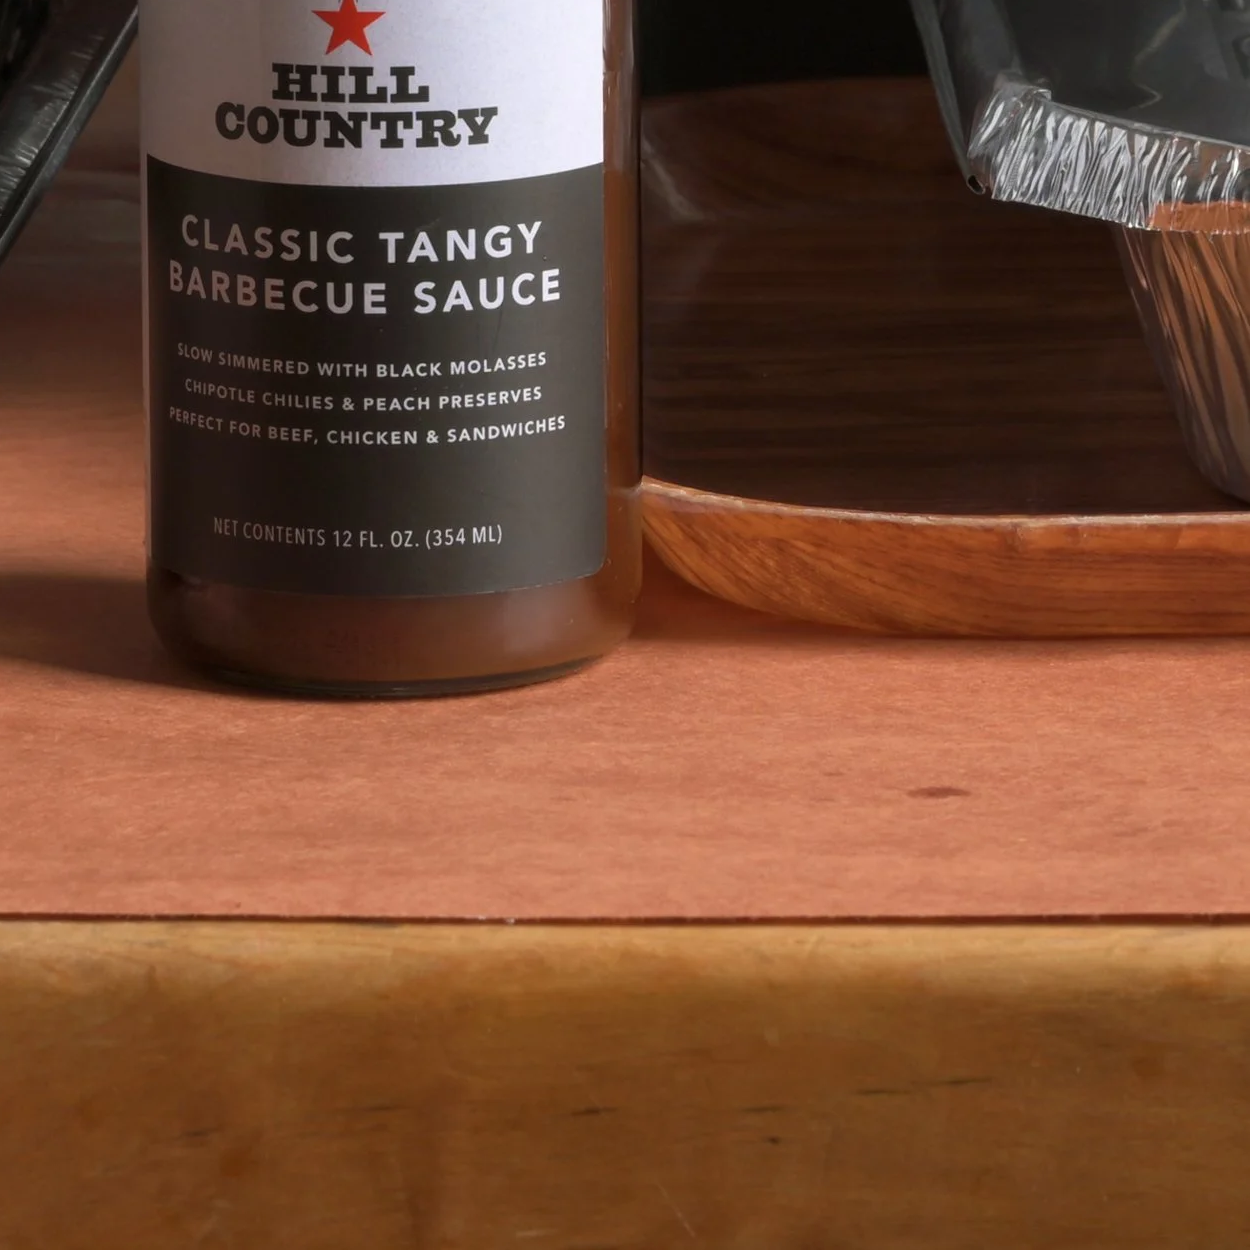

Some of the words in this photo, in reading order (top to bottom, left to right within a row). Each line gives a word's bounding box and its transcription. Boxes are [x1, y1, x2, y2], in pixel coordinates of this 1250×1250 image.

[272, 62, 430, 104] HILL
[215, 102, 498, 148] COUNTRY
[182, 214, 354, 264] CLASSIC
[379, 221, 542, 264] TANGY
[169, 260, 387, 314] BARBECUE
[413, 268, 561, 314] SAUCE
[177, 343, 213, 364] SLOW
[218, 352, 309, 375] SIMMERED
[317, 362, 367, 378] WITH
[376, 362, 442, 378] BLACK
[450, 352, 547, 376] MOLASSES
[185, 378, 255, 404] CHIPOTLE
[262, 392, 334, 410] CHILIES
[342, 397, 355, 411] &
[363, 397, 430, 411] PEACH
[439, 386, 542, 409] PRESERVES
[169, 407, 224, 432] PERFECT
[229, 421, 261, 437] FOR
[267, 426, 318, 445] BEEF,
[326, 430, 418, 445] CHICKEN
[426, 430, 439, 444] &
[447, 415, 566, 443] SANDWICHES
[213, 517, 239, 536] NET
[243, 522, 326, 546] CONTENTS
[332, 530, 352, 547] 12
[359, 531, 384, 548] FL.
[391, 530, 419, 548] OZ.
[425, 528, 466, 549] (354
[472, 524, 503, 545] ML)
